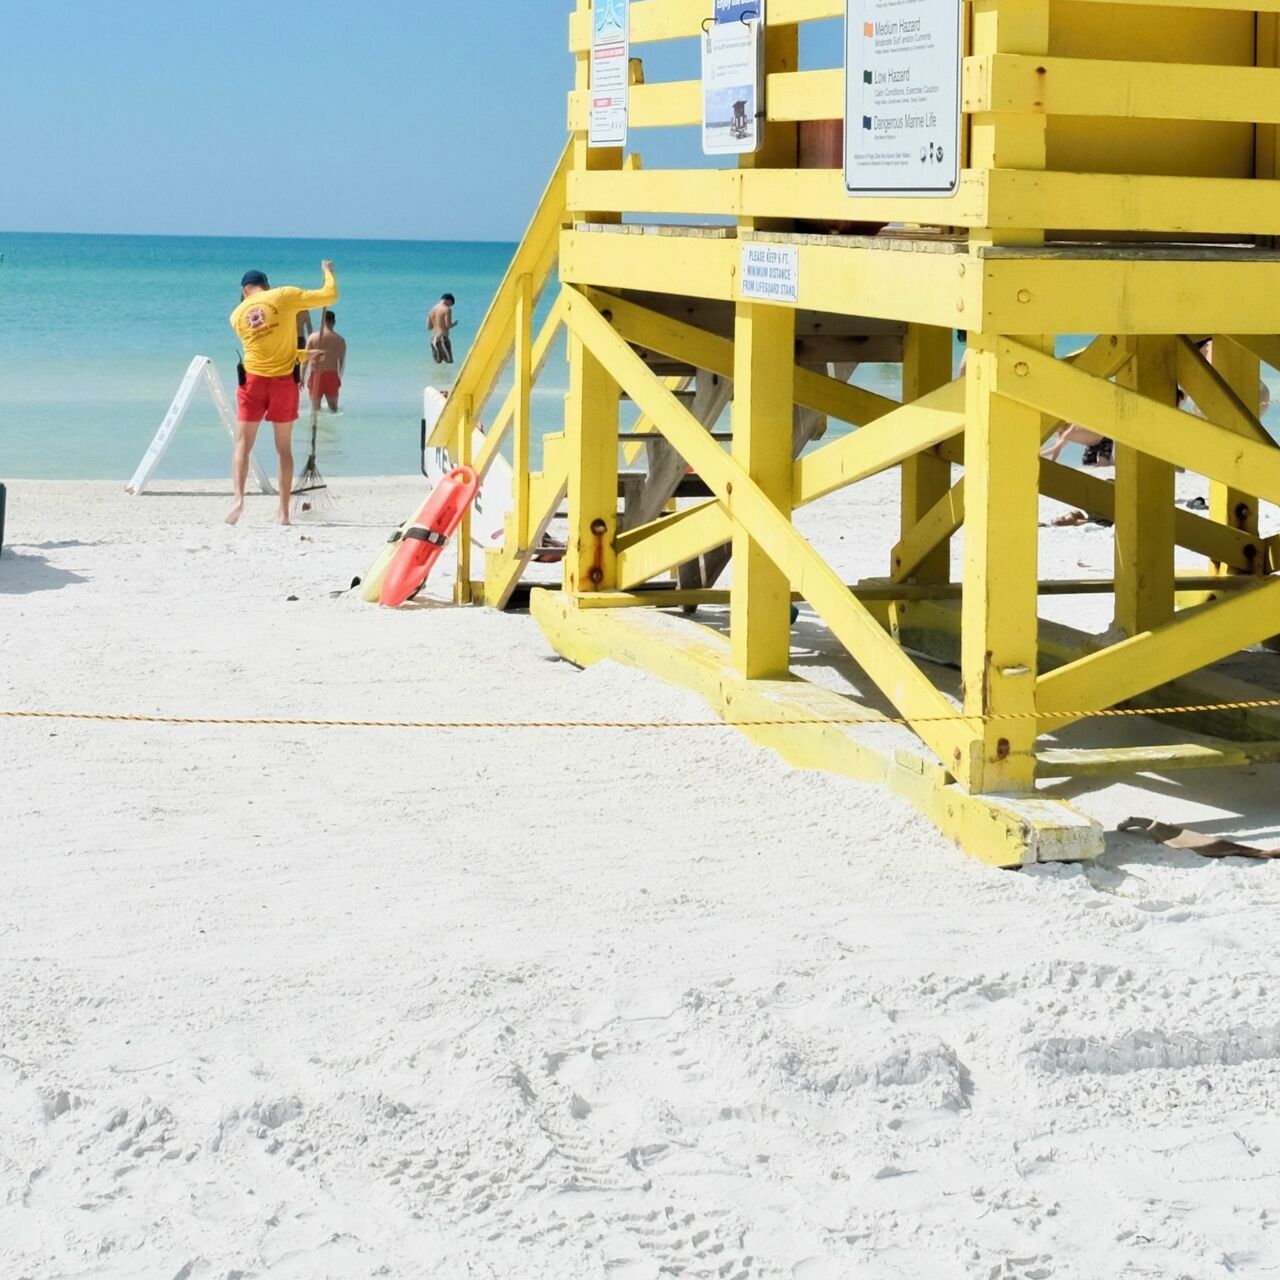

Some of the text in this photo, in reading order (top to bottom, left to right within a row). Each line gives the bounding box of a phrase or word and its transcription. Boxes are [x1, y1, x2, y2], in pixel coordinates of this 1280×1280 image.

[875, 17, 920, 36] Medium Hazard
[875, 67, 910, 84] Low Hazard
[874, 112, 936, 133] Dangerous Marine Life
[749, 250, 765, 262] PLEASE
[766, 252, 777, 263] KEEP
[747, 265, 792, 280] MINIMUM DISTANCE
[742, 280, 796, 296] FROM LIFEGUARD STAND
